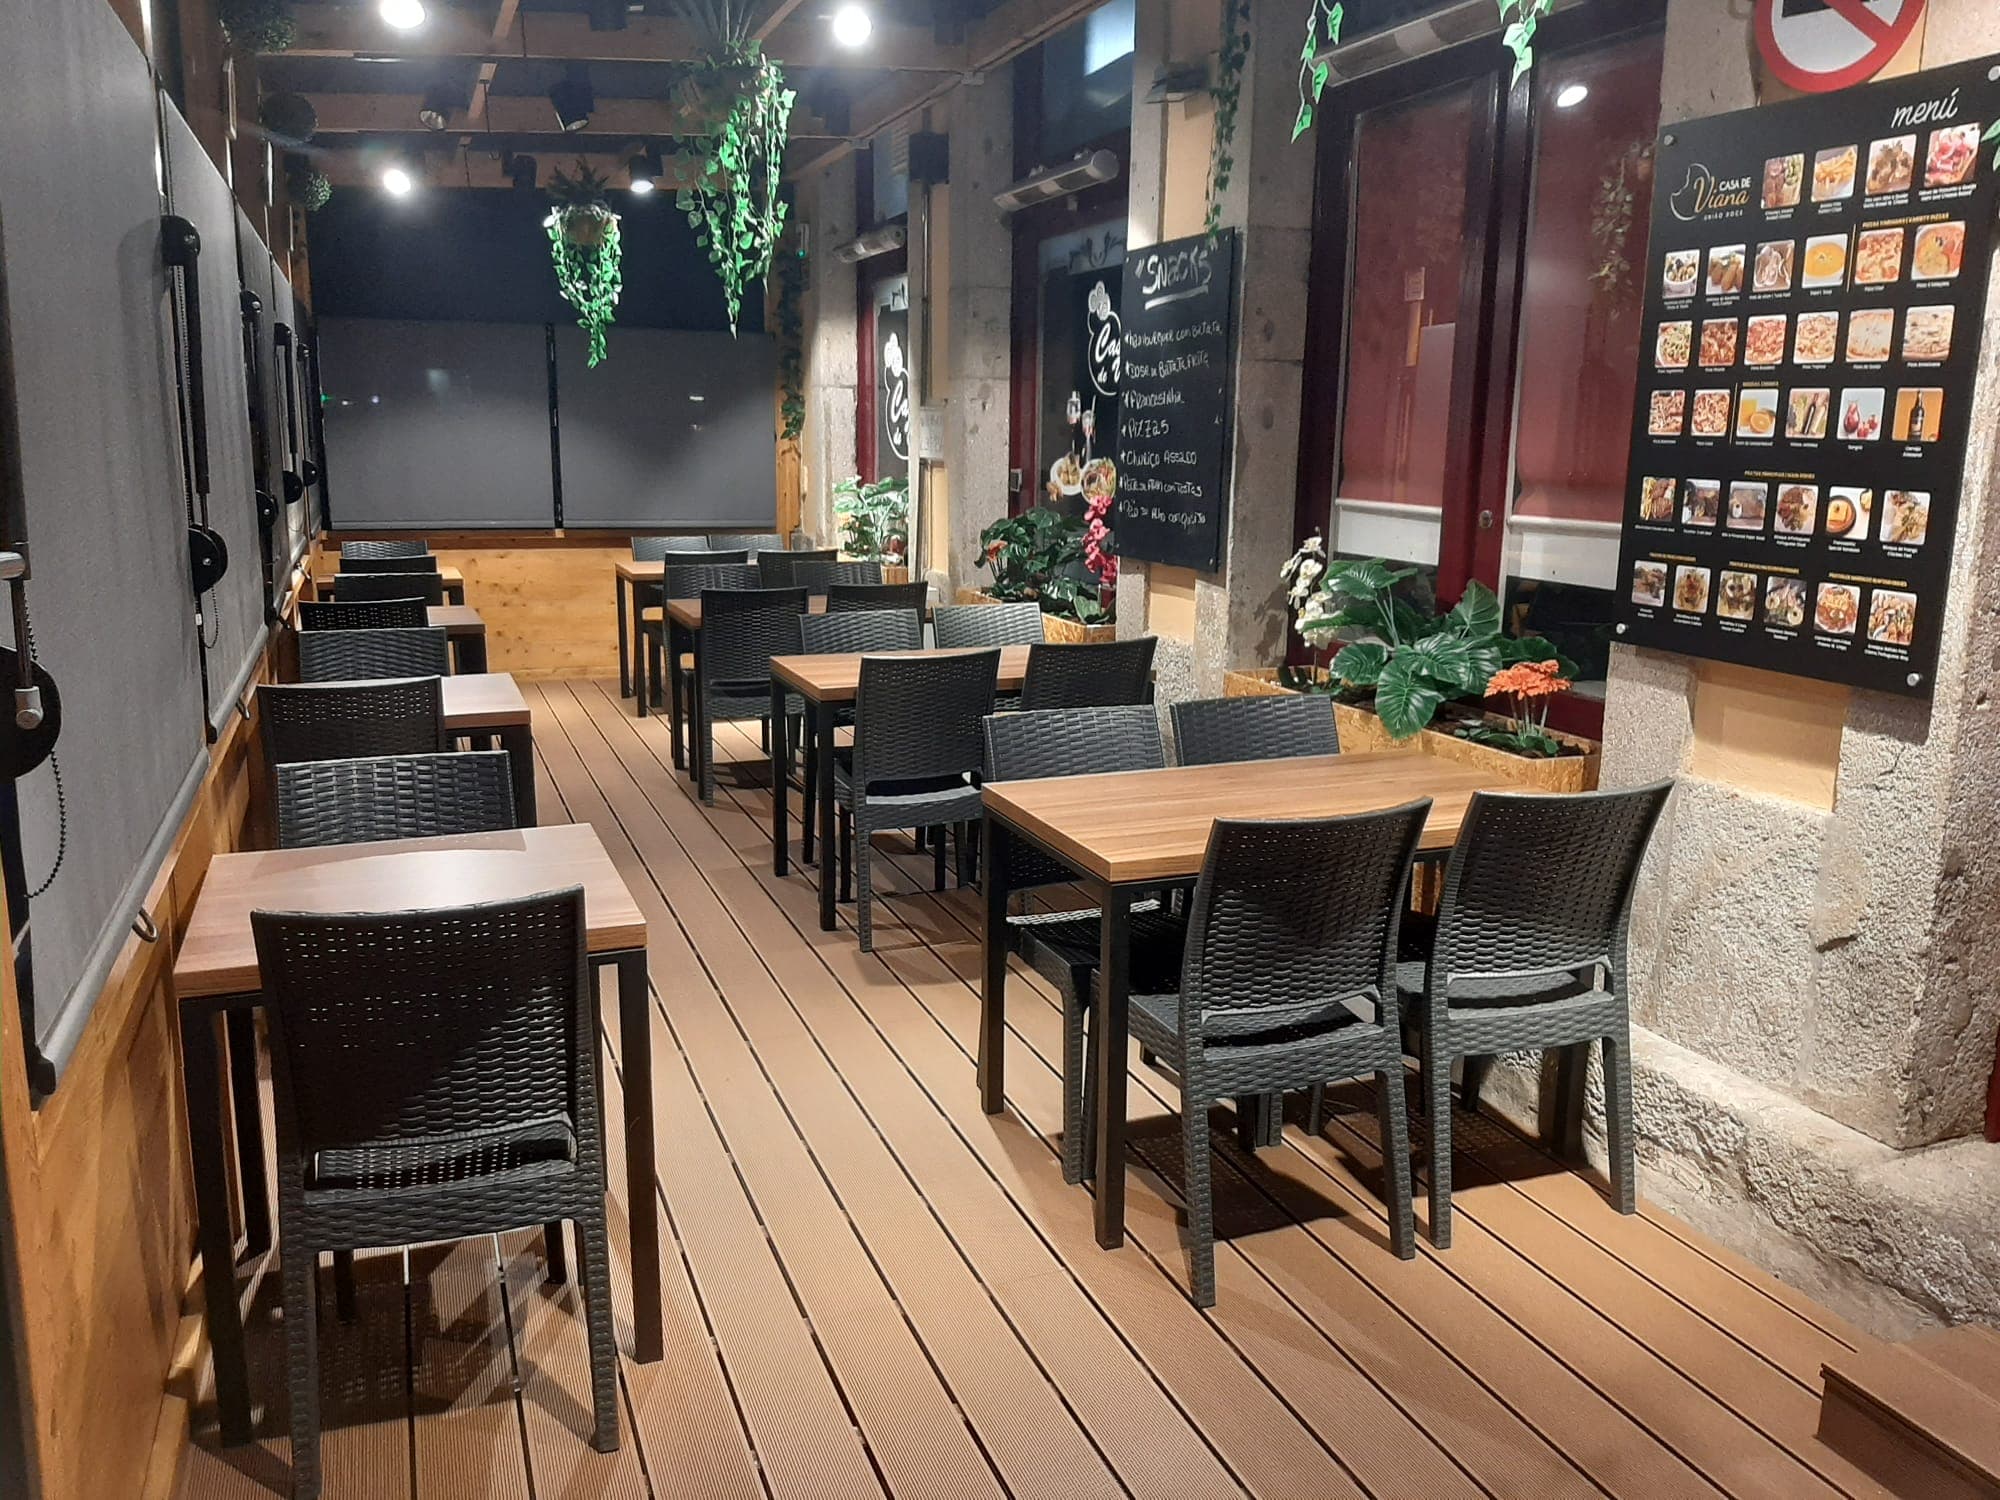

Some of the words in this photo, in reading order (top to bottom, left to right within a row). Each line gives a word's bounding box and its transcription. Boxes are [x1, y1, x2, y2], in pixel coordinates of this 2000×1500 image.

[1891, 87, 1960, 129] menú
[1693, 176, 1750, 213] Viana
[1719, 179, 1740, 191] CASA
[1741, 176, 1751, 189] DE
